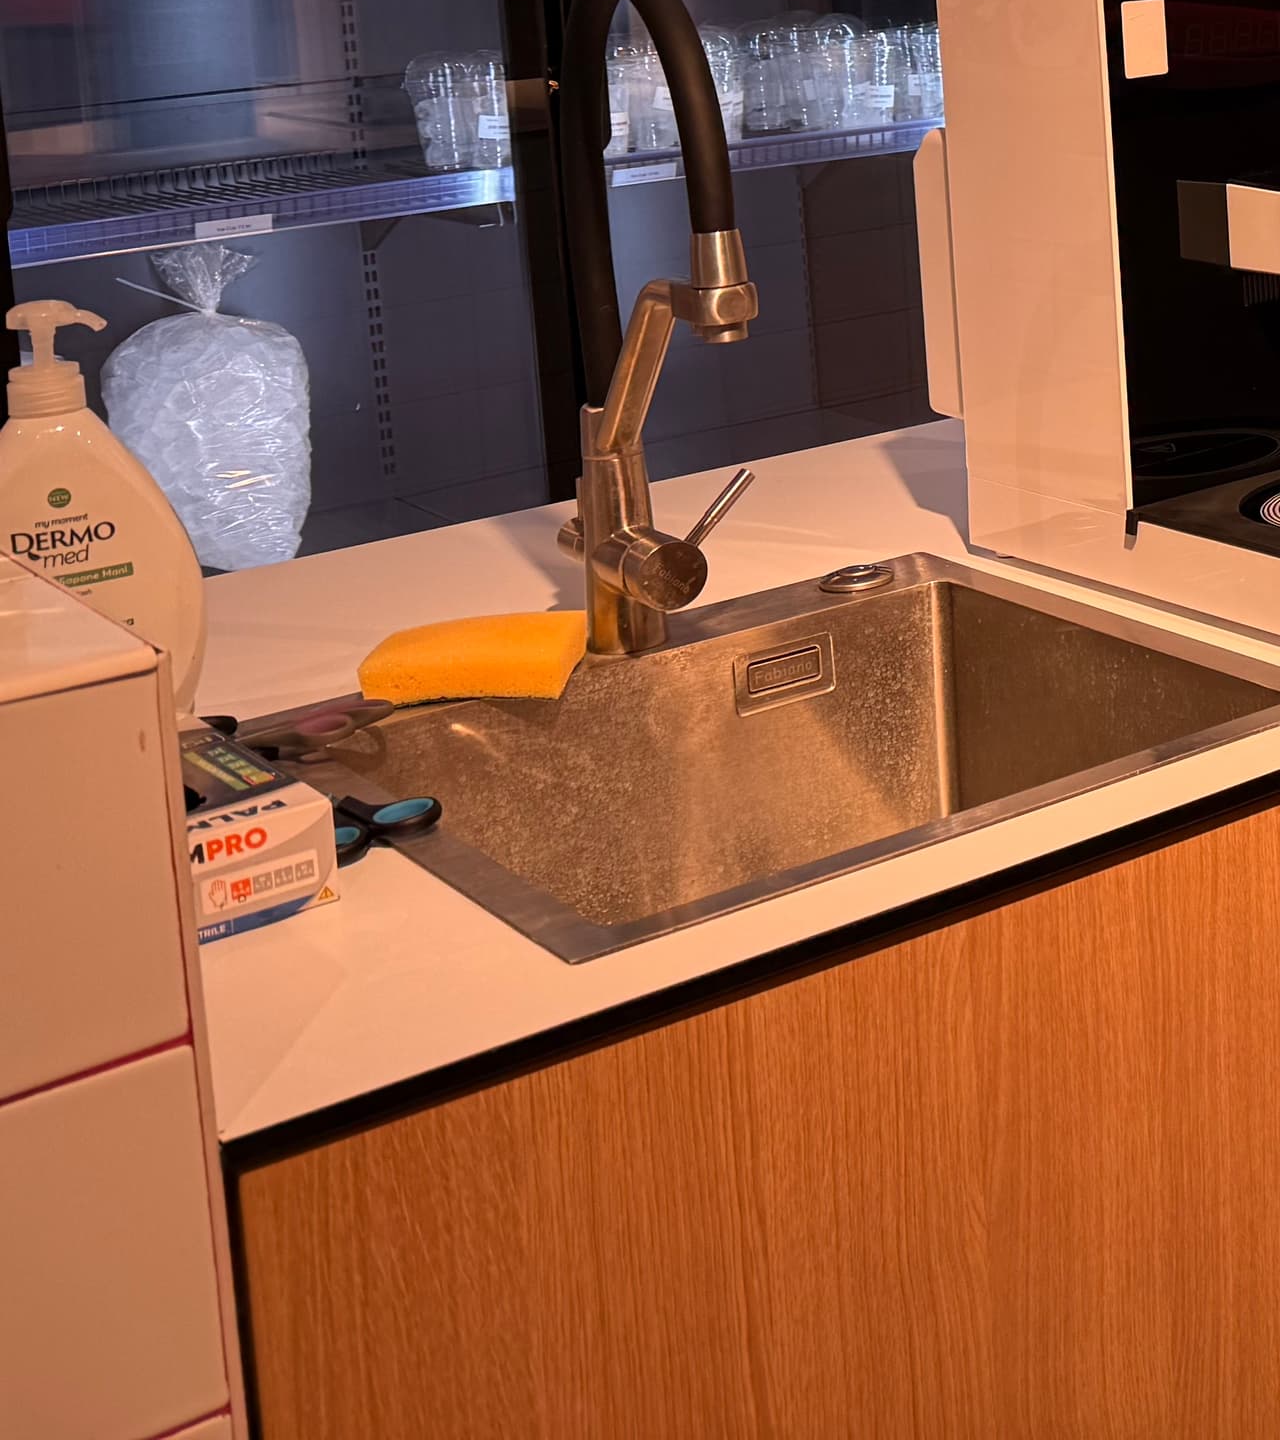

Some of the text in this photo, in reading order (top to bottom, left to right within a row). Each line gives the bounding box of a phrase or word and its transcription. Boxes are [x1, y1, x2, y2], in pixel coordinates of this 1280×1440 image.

[35, 513, 88, 529] my moment
[10, 521, 115, 555] DERMO
[43, 543, 90, 568] med
